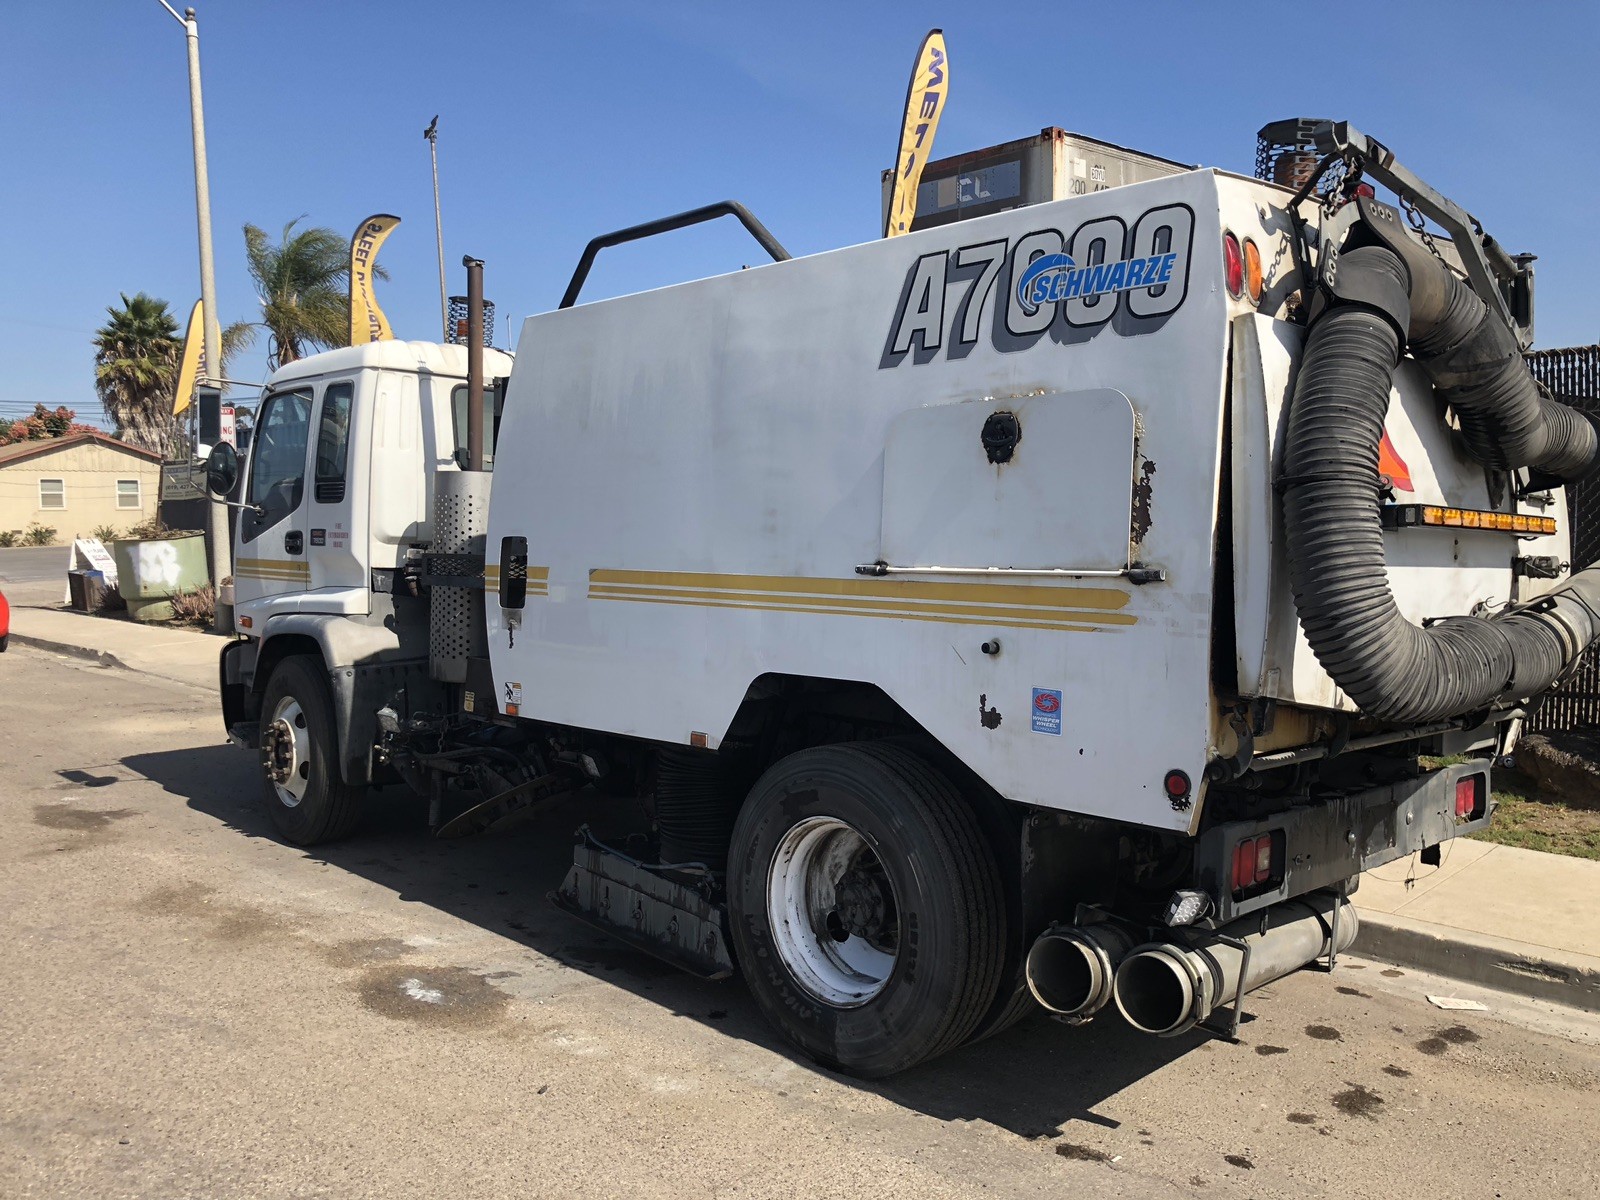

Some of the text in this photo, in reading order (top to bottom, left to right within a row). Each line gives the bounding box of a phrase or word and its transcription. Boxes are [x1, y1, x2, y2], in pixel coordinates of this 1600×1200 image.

[879, 202, 1196, 369] A7000
[1031, 252, 1178, 304] SCHWARZE
[1032, 715, 1060, 724] WHISPER
